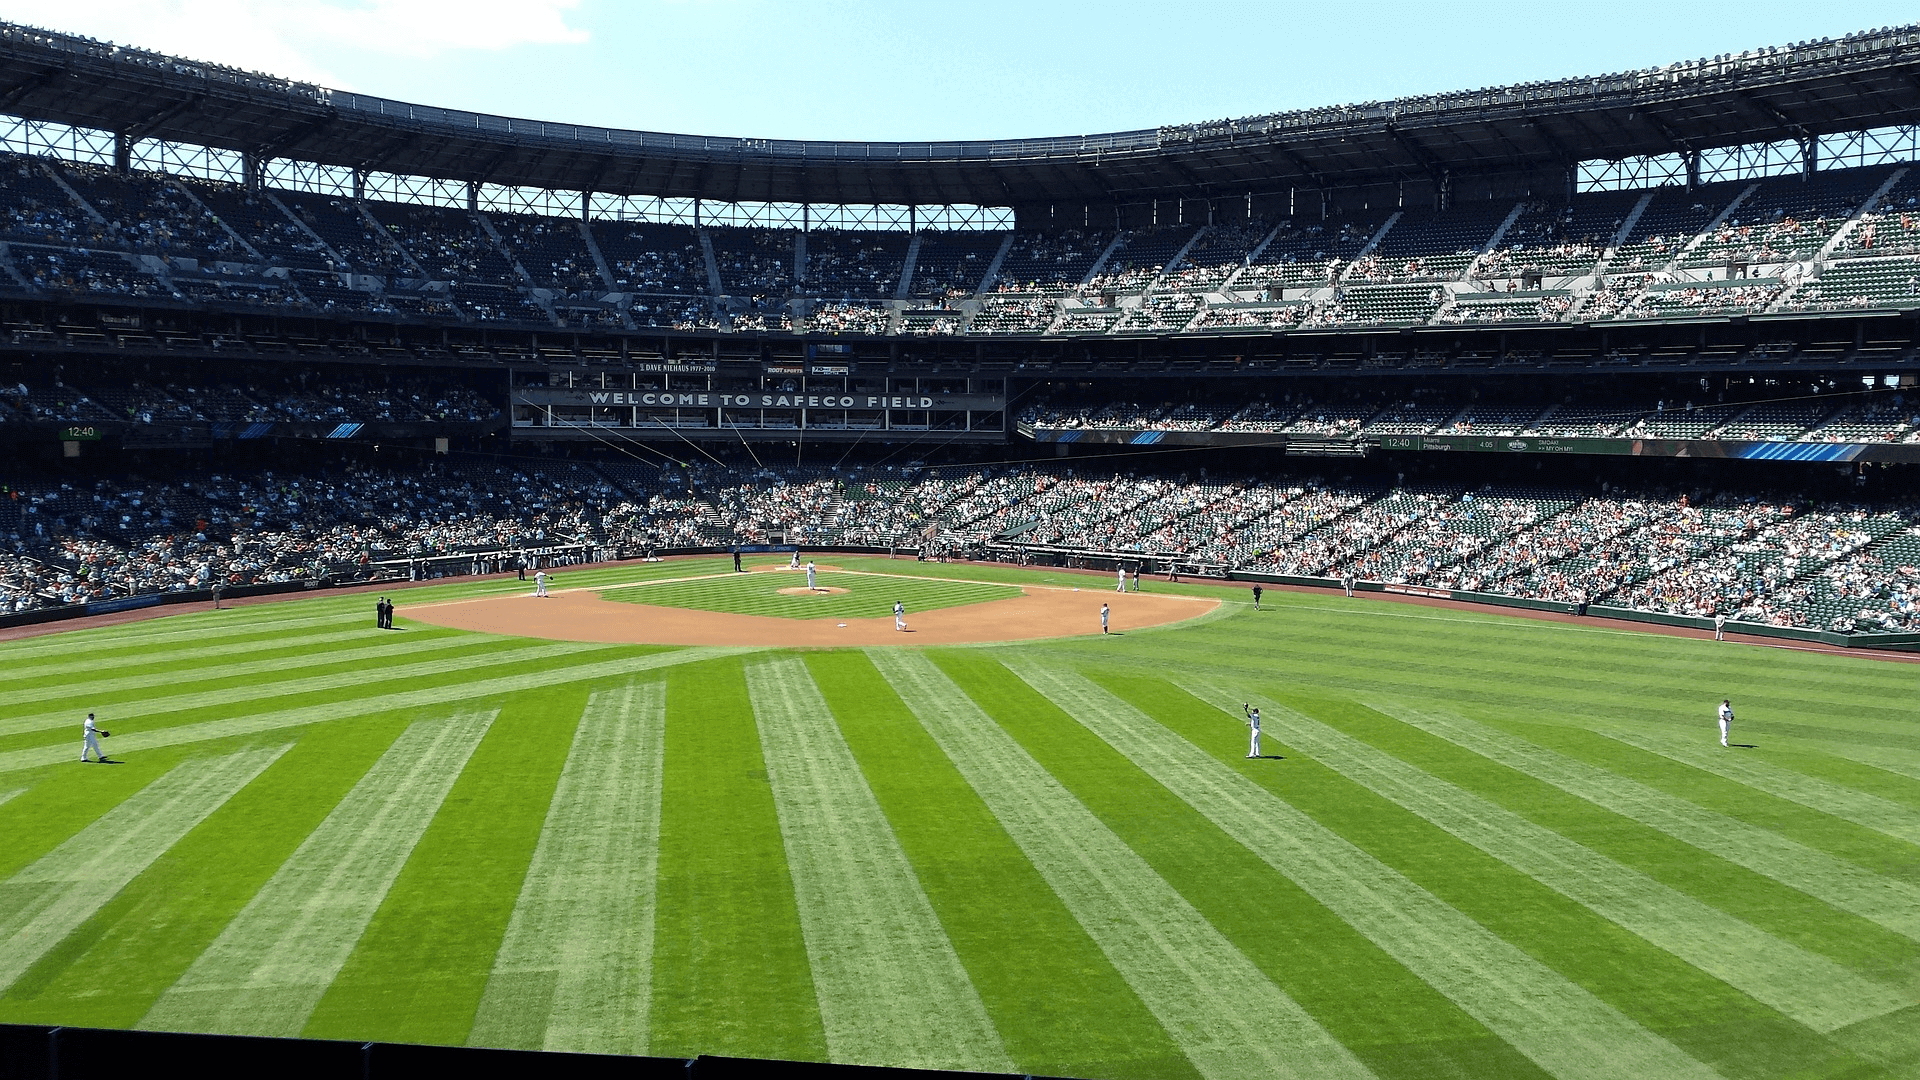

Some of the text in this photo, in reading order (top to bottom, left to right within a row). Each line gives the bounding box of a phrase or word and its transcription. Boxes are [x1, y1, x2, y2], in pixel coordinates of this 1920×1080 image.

[645, 364, 662, 372] DAVE
[663, 364, 689, 372] NIEHAUS
[588, 392, 933, 408] WELCOME TO SAFECO FIELD
[68, 426, 94, 437] 12:40
[1388, 438, 1410, 447] 12:40
